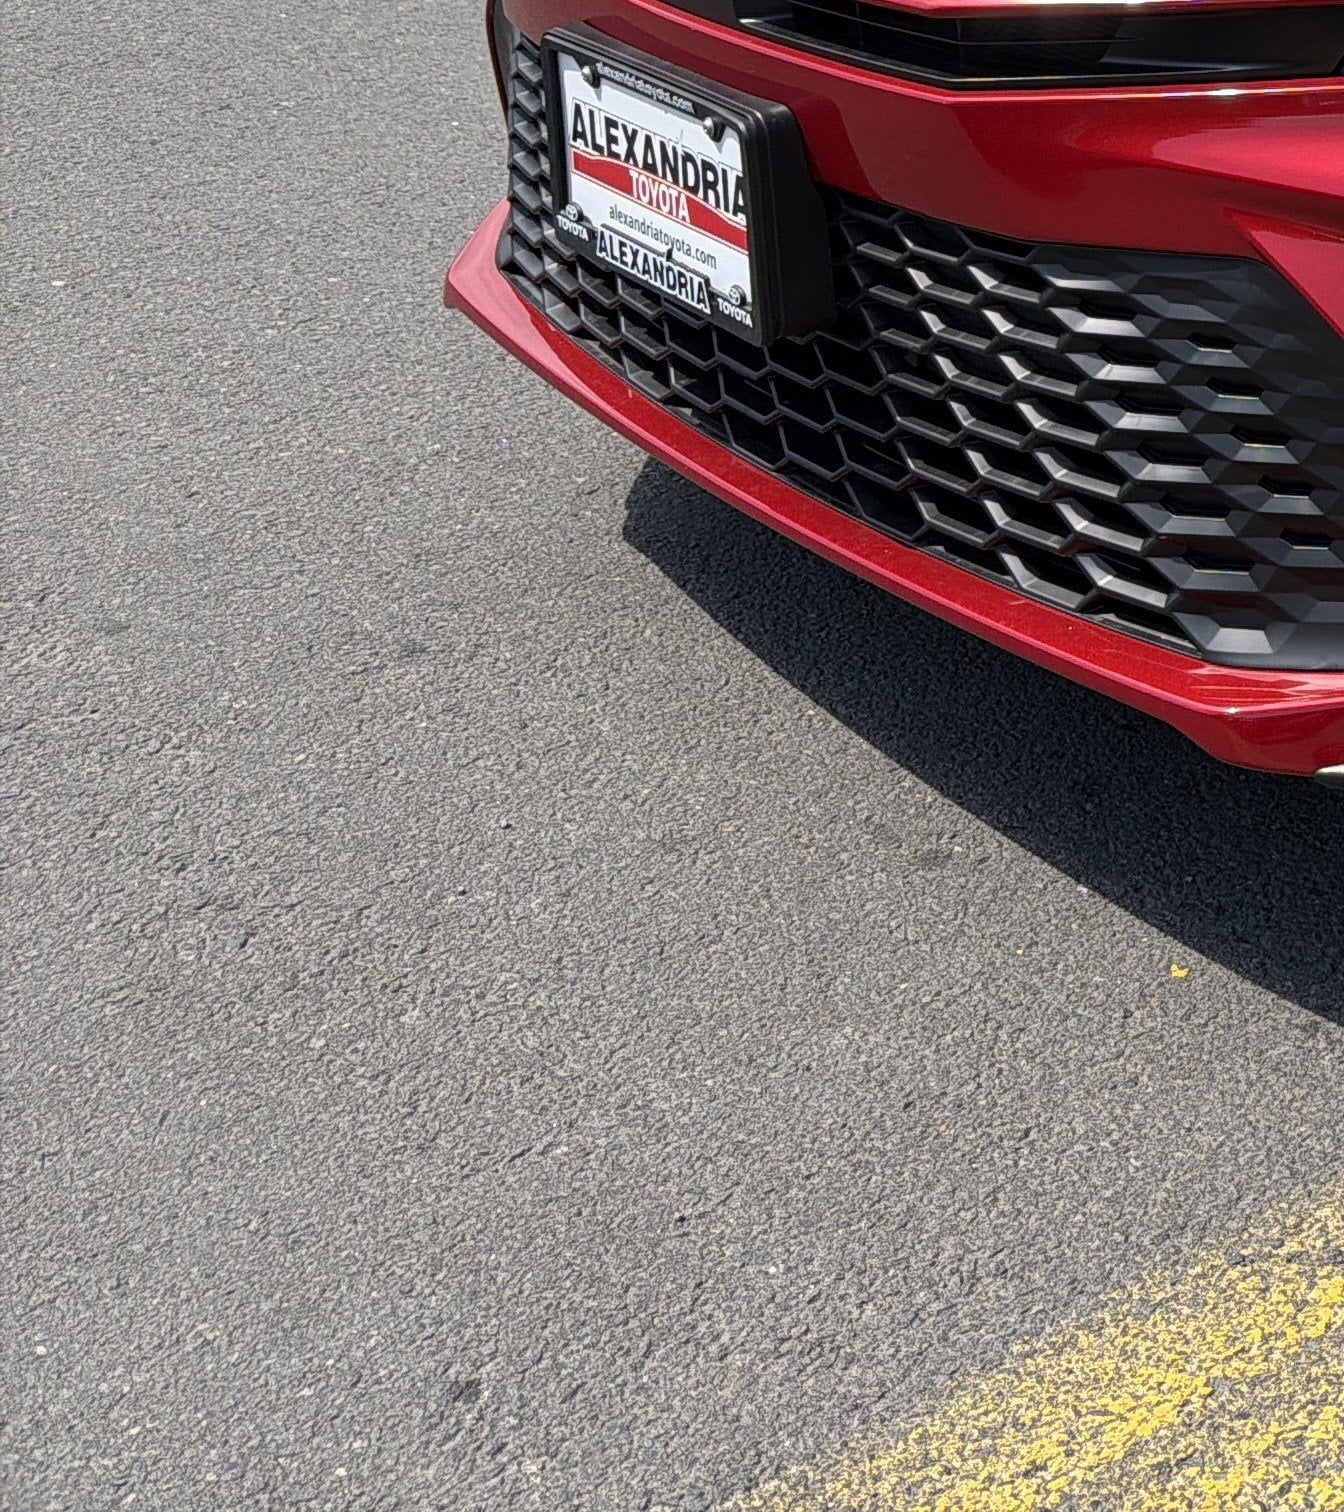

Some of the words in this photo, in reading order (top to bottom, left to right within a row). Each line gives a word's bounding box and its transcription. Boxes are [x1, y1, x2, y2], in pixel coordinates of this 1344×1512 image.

[571, 99, 747, 221] ALEXANDRIA
[629, 170, 691, 224] TOYOTA
[556, 214, 589, 242] TOYOTA
[608, 204, 717, 270] alexandriatoyota.com
[597, 228, 711, 314] ALEXANDRIA
[717, 297, 753, 328] TOYOTA
